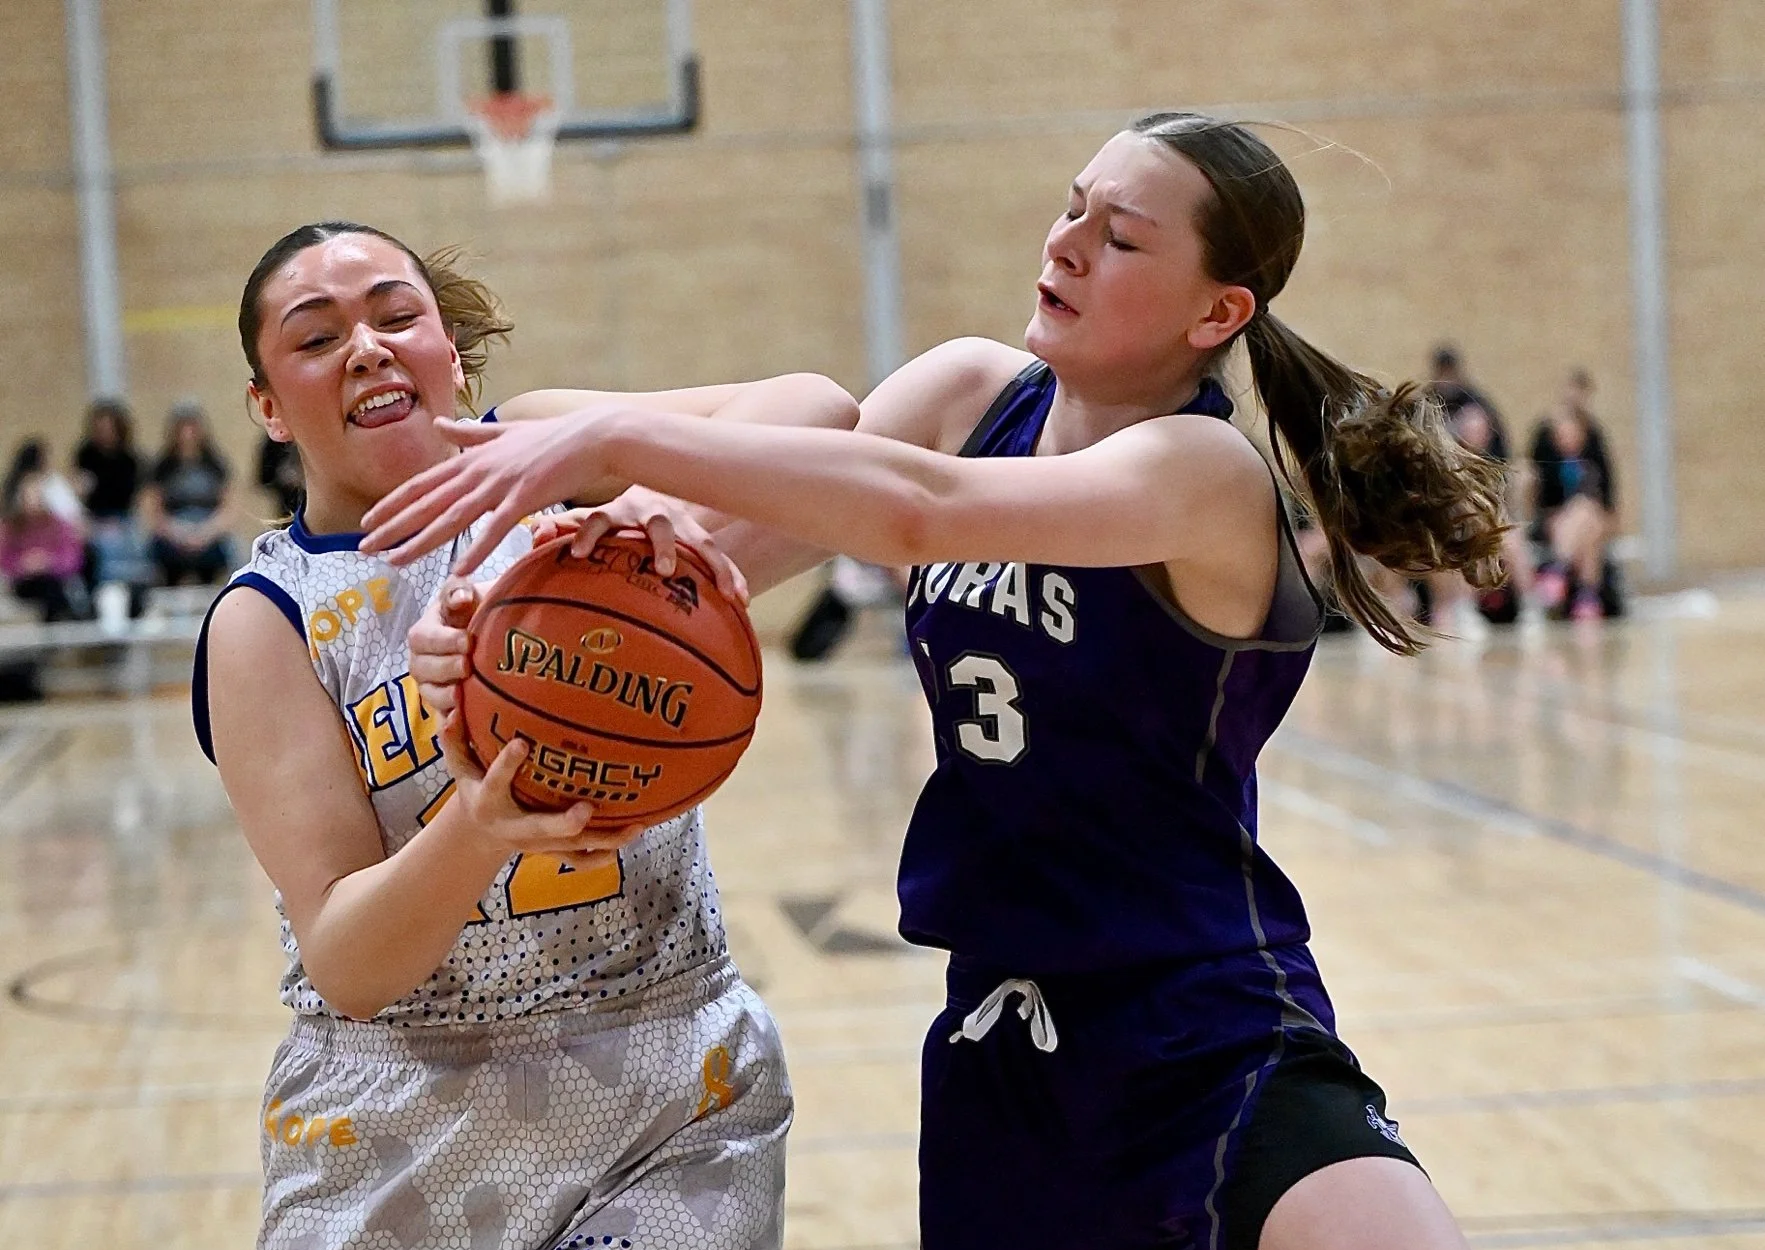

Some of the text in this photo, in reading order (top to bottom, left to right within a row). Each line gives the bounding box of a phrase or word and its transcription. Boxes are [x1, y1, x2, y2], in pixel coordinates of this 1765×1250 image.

[309, 577, 394, 659] OPE
[496, 627, 694, 729] SPALDING
[919, 637, 1028, 767] 3
